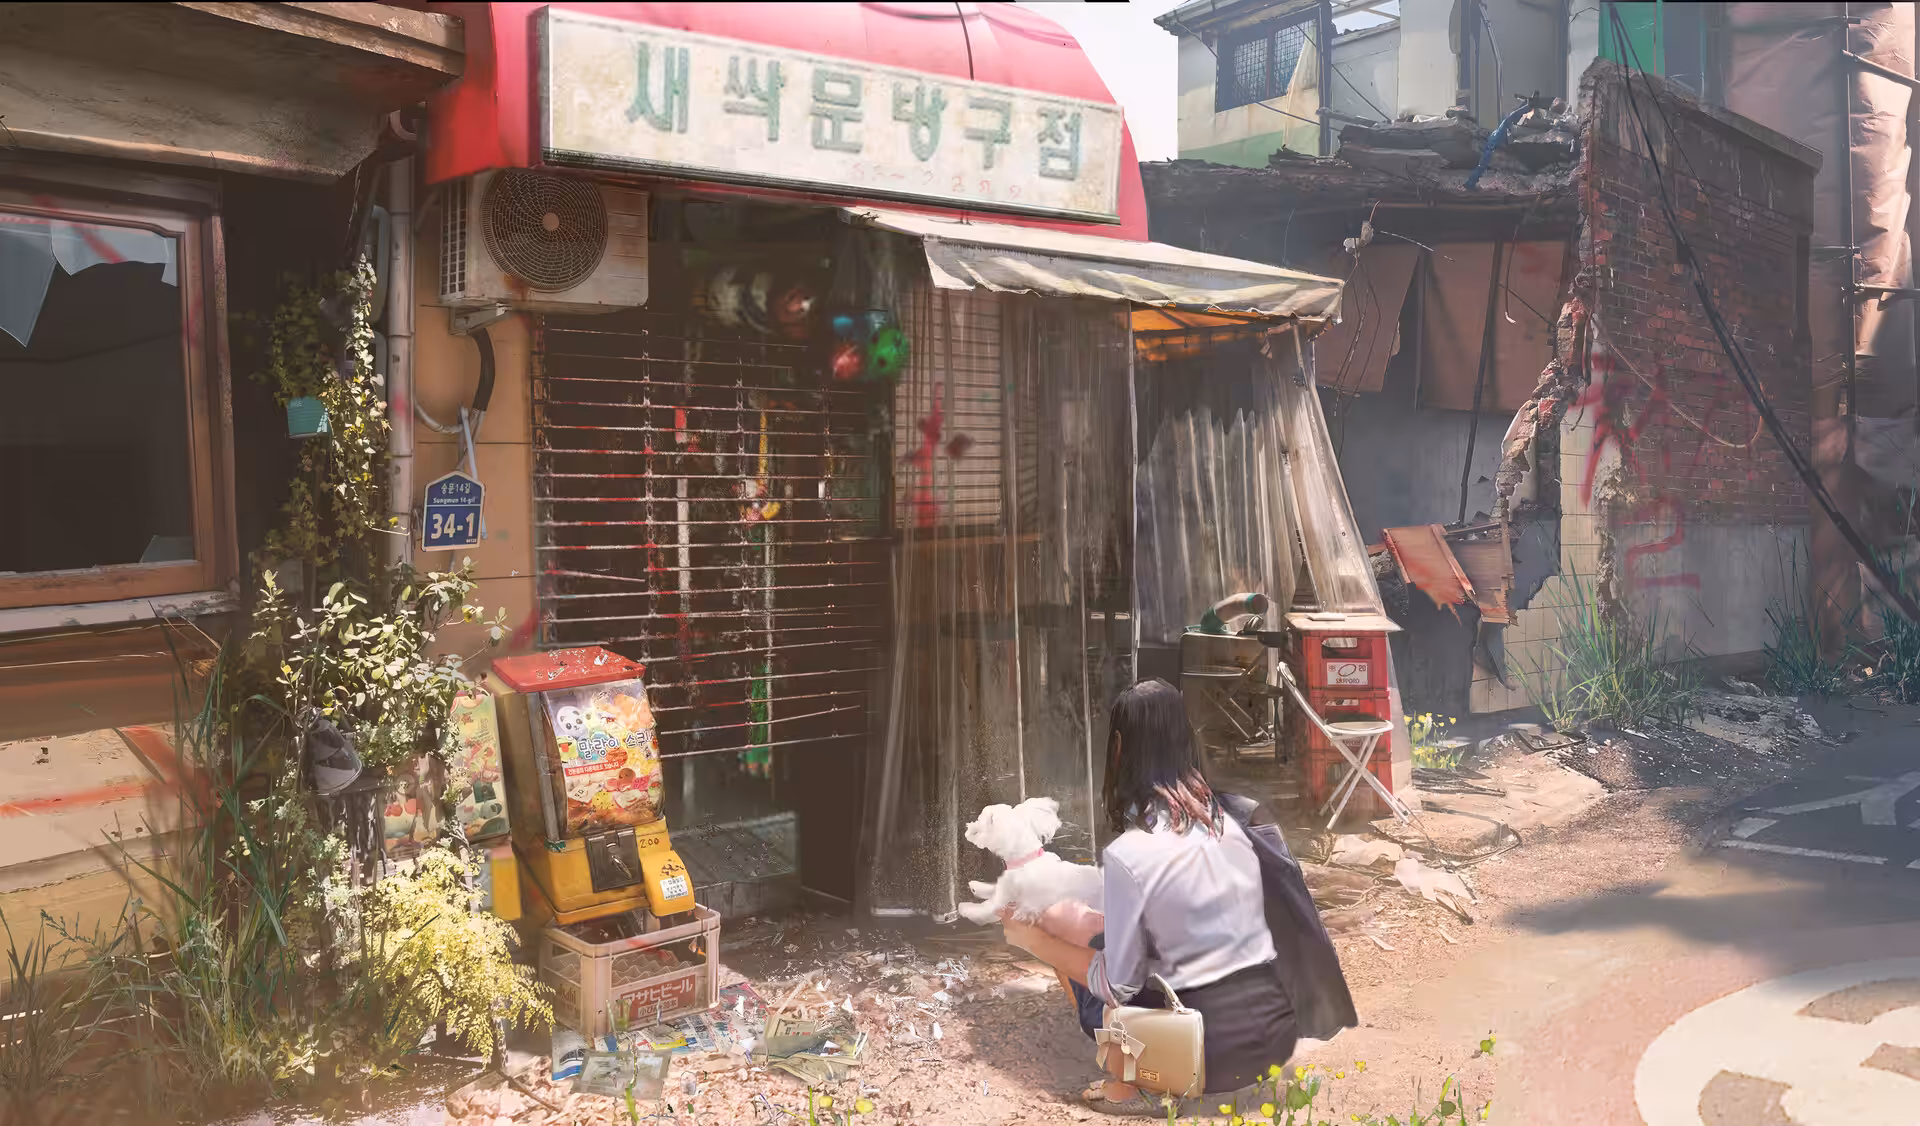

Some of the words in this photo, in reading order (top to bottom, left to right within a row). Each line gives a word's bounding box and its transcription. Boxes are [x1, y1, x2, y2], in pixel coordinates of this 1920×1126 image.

[431, 513, 475, 539] 34-1
[577, 738, 620, 760] 말랑이
[640, 838, 659, 848] 200
